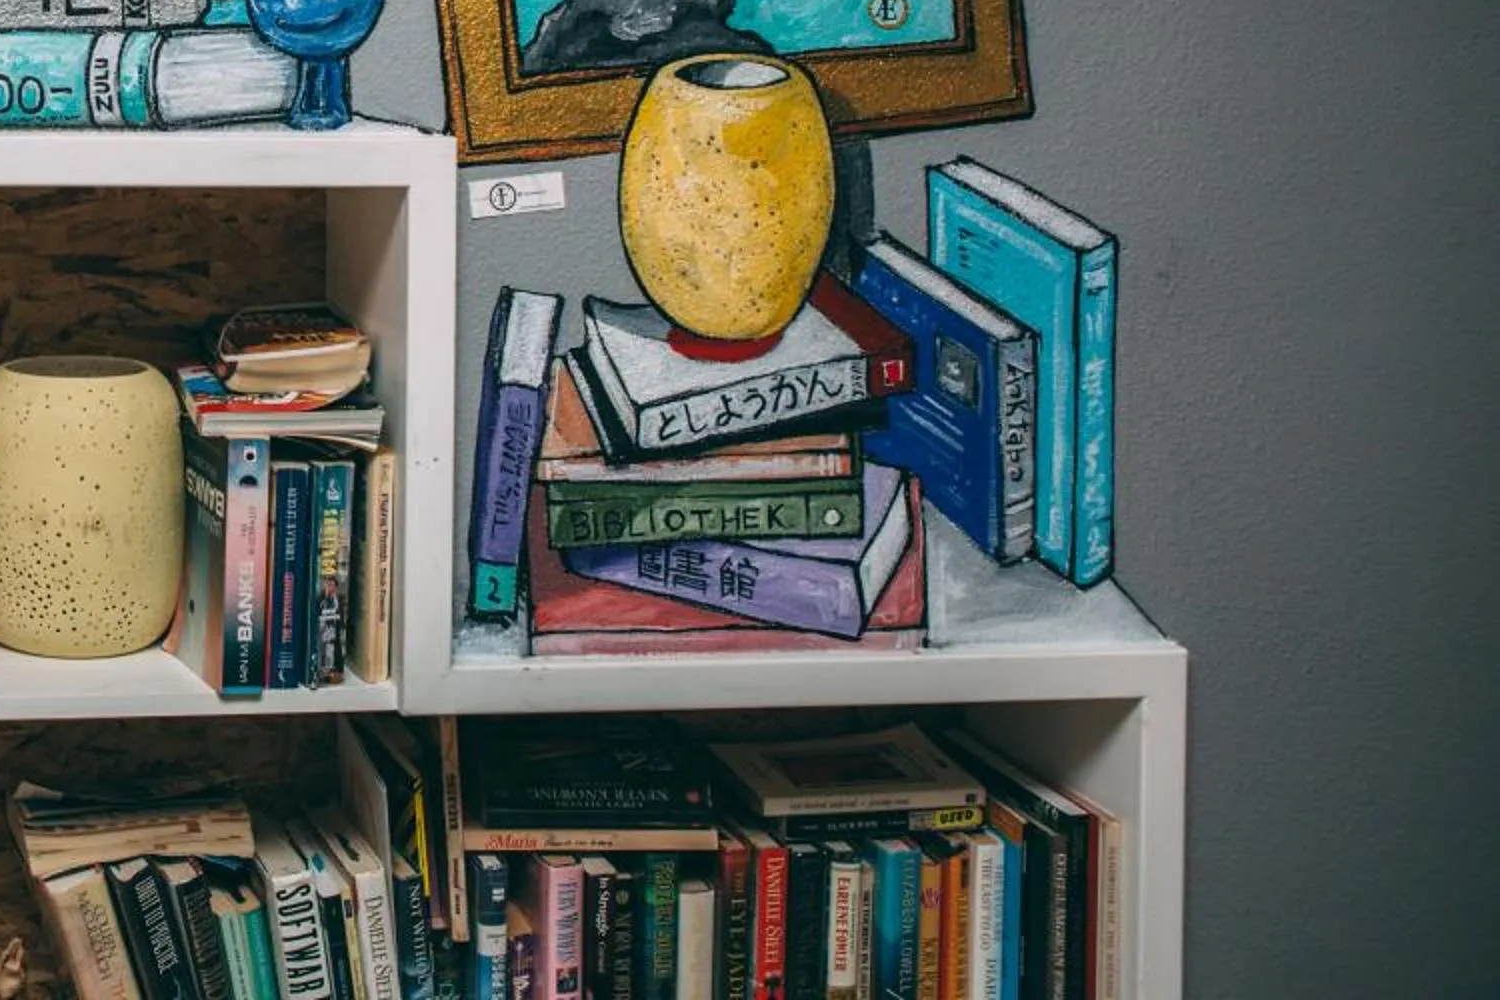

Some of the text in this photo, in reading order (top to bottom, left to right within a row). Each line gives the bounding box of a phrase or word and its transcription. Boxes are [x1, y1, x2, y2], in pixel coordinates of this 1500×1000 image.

[94, 58, 113, 113] ZULU
[572, 503, 790, 541] BIBLIOTHEK
[238, 560, 255, 642] BANKS
[486, 574, 502, 604] 2
[938, 809, 975, 826] USED
[134, 876, 179, 975] UNFIT TO PRACTICE
[364, 895, 389, 960] DANIELLE
[409, 883, 421, 917] NOT
[765, 856, 784, 963] DANIELLE STEEL
[835, 878, 851, 971] EARLENE FOWLER
[899, 858, 917, 992] ELIZABETH LOWELL
[93, 904, 118, 960] COLLEEN
